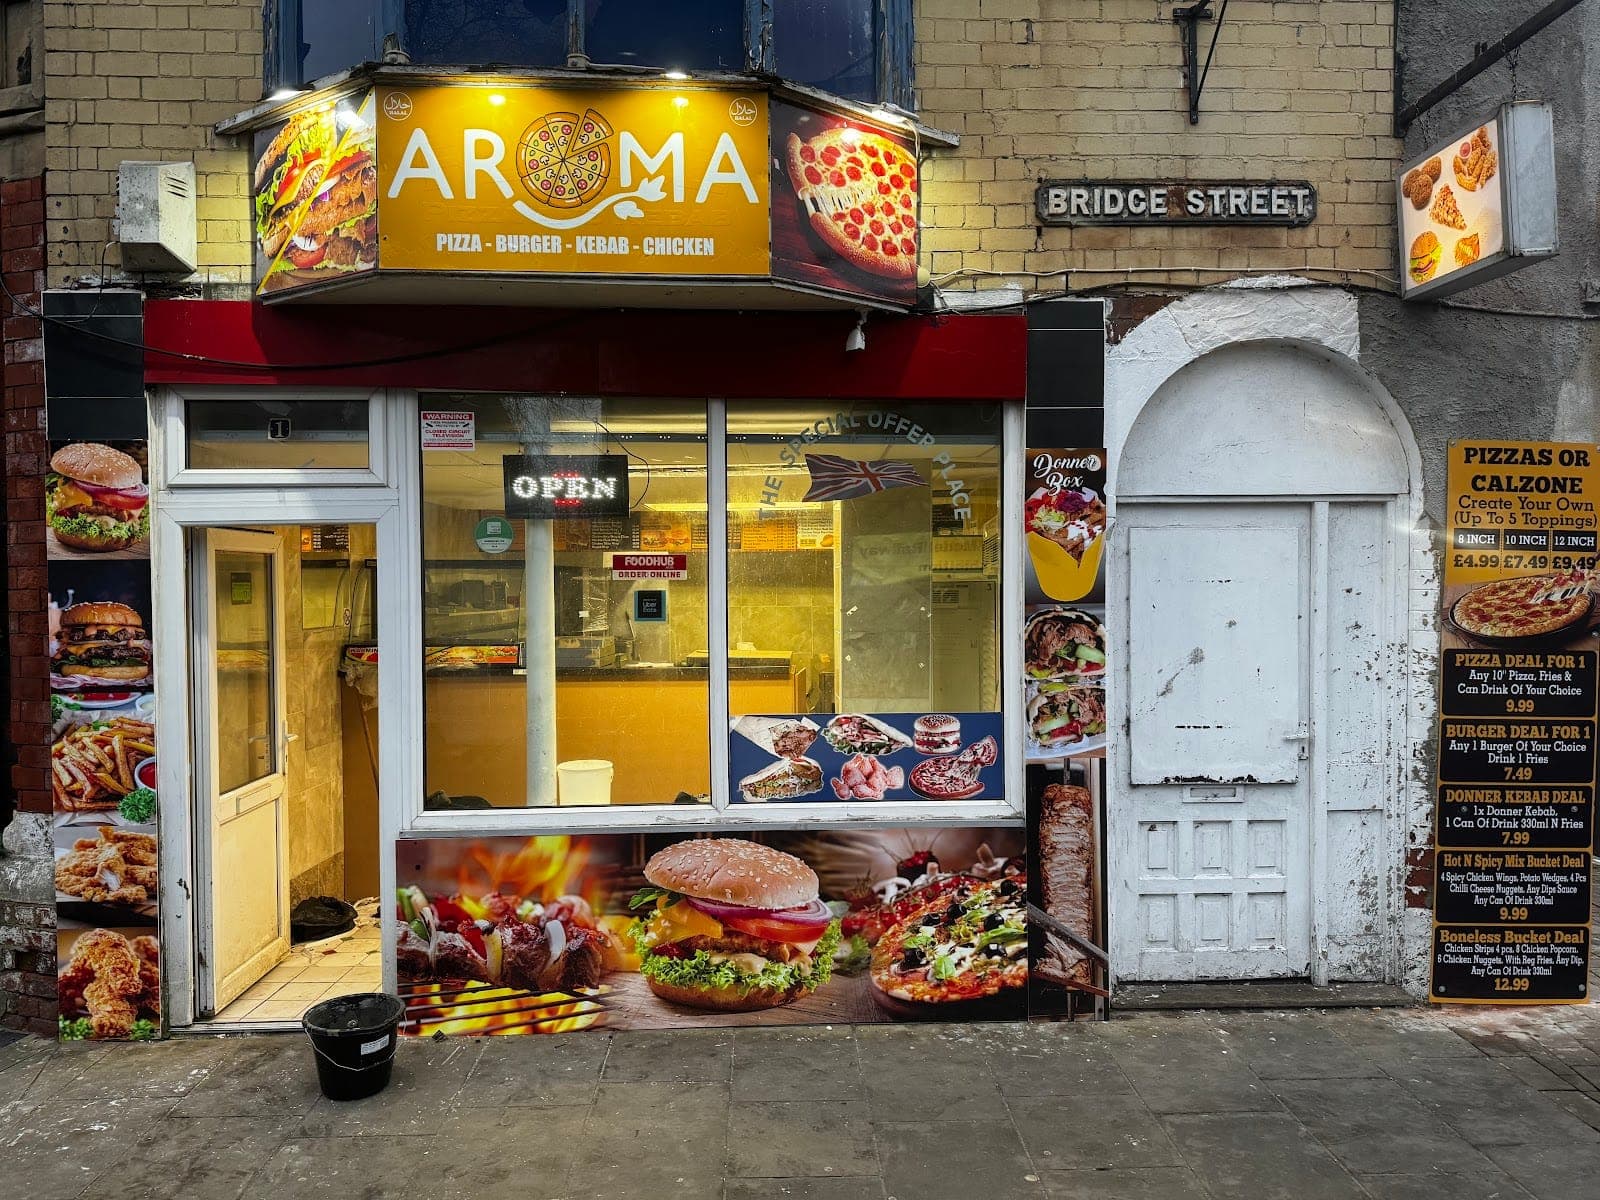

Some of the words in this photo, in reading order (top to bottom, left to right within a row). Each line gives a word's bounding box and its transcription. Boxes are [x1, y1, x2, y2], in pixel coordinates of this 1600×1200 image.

[1048, 188, 1168, 215] BRIDGE
[1186, 188, 1310, 215] STREET
[436, 233, 482, 253] PIZZA
[495, 234, 562, 253] BURGER
[575, 235, 630, 255] KEBAB
[643, 236, 714, 256] CHICKEN
[275, 421, 285, 437] 1
[1464, 447, 1553, 466] PIZZAS
[1559, 449, 1591, 467] OR
[758, 475, 783, 520] THE
[780, 409, 861, 469] SPECIAL
[867, 410, 936, 449] OFFER
[932, 451, 972, 521] PLACE
[512, 476, 618, 499] OPEN
[1046, 472, 1083, 496] Box
[1471, 475, 1583, 494] CALZONE
[1458, 495, 1513, 510] Create
[1517, 496, 1551, 511] Your
[1556, 497, 1594, 512] Own
[1454, 511, 1482, 527] (Up
[1487, 511, 1504, 524] To
[1509, 513, 1517, 525] 5
[1521, 513, 1598, 529] Toppings)
[1458, 535, 1465, 544] 8
[1467, 534, 1496, 545] INCH
[1505, 535, 1517, 545] 10
[1518, 535, 1547, 546] INCH
[1554, 535, 1565, 546] 12
[1567, 536, 1595, 547] INCH
[625, 556, 674, 567] FOODHUB
[1453, 554, 1500, 568] £4.99
[1504, 555, 1548, 569] £7.49
[1552, 556, 1596, 570] £9.49
[618, 571, 647, 579] ORDER
[650, 571, 681, 579] ONLINE
[1455, 653, 1502, 667] PIZZA
[1505, 654, 1544, 668] DEAL
[1546, 655, 1576, 668] FOR
[1579, 655, 1586, 669] 1
[1469, 669, 1490, 682] Any
[1508, 670, 1537, 682] Pizza,
[1539, 670, 1562, 681] Fries
[1564, 671, 1572, 682] &
[1457, 683, 1479, 694] Can
[1481, 683, 1509, 695] Drink
[1510, 684, 1524, 695] Of
[1525, 684, 1546, 695] Your
[1548, 684, 1583, 696] Choice
[1506, 699, 1535, 713] 9.99
[1446, 724, 1508, 738] BURGER
[1510, 725, 1549, 739] DEAL
[1551, 726, 1581, 739] FOR
[1584, 726, 1591, 739] 1
[1449, 739, 1470, 753] Any
[1473, 740, 1477, 751] 1
[1480, 740, 1514, 754] Burger
[1515, 740, 1529, 751] Of
[1530, 740, 1551, 751] Your
[1553, 741, 1587, 752] Choice
[1487, 753, 1516, 764] Drink
[1518, 753, 1522, 764] 1
[1525, 753, 1549, 764] Fries
[1504, 767, 1533, 781] 7.49
[1445, 789, 1503, 803] DONNER
[1504, 790, 1550, 803] KEBAB
[1551, 790, 1586, 804] DEAL
[1473, 805, 1485, 816] 1x
[1486, 805, 1523, 816] Donner
[1445, 817, 1450, 828] 1
[1452, 817, 1474, 828] Can
[1476, 818, 1490, 828] Of
[1491, 818, 1519, 829] Drink
[1521, 818, 1549, 829] 330ml
[1551, 818, 1559, 829] N
[1560, 818, 1584, 829] Fries
[1501, 831, 1530, 845] 7.99
[1443, 853, 1461, 867] Hot
[1463, 854, 1473, 867] N
[1474, 854, 1503, 870] Spicy
[1505, 854, 1525, 867] Mix
[1526, 854, 1560, 868] Bucket
[1562, 854, 1585, 868] Deal
[1440, 872, 1445, 881] 4
[1446, 871, 1465, 883] Spicy
[1466, 871, 1495, 882] Chicken
[1520, 873, 1541, 882] Potato
[1570, 873, 1574, 882] 4
[1575, 873, 1587, 883] Pcs
[1449, 883, 1469, 893] Chilli
[1470, 883, 1495, 893] Cheese
[1526, 884, 1541, 895] Any
[1541, 884, 1556, 895] Dips
[1557, 884, 1578, 894] Sauce
[1473, 895, 1488, 906] Any
[1489, 895, 1504, 905] Can
[1504, 895, 1514, 905] Of
[1514, 895, 1533, 905] Drink
[1534, 896, 1554, 905] 330ml
[1500, 907, 1529, 921] 9.99
[1439, 929, 1501, 943] Boneless
[1504, 930, 1551, 943] Bucket
[1554, 930, 1585, 944] Deal
[1444, 943, 1473, 953] Chicken
[1474, 944, 1495, 955] Strips
[1496, 945, 1500, 953] 4
[1515, 945, 1520, 953] 8
[1521, 944, 1549, 954] Chicken
[1437, 954, 1442, 963] 6
[1443, 954, 1472, 964] Chicken
[1505, 955, 1521, 964] With
[1522, 955, 1535, 966] Reg
[1555, 956, 1570, 967] Any
[1471, 966, 1486, 977] Any
[1486, 966, 1501, 975] Can
[1502, 966, 1512, 975] Of
[1512, 966, 1532, 976] Drink
[1532, 967, 1552, 976] 330ml
[1494, 978, 1530, 991] 12.99
